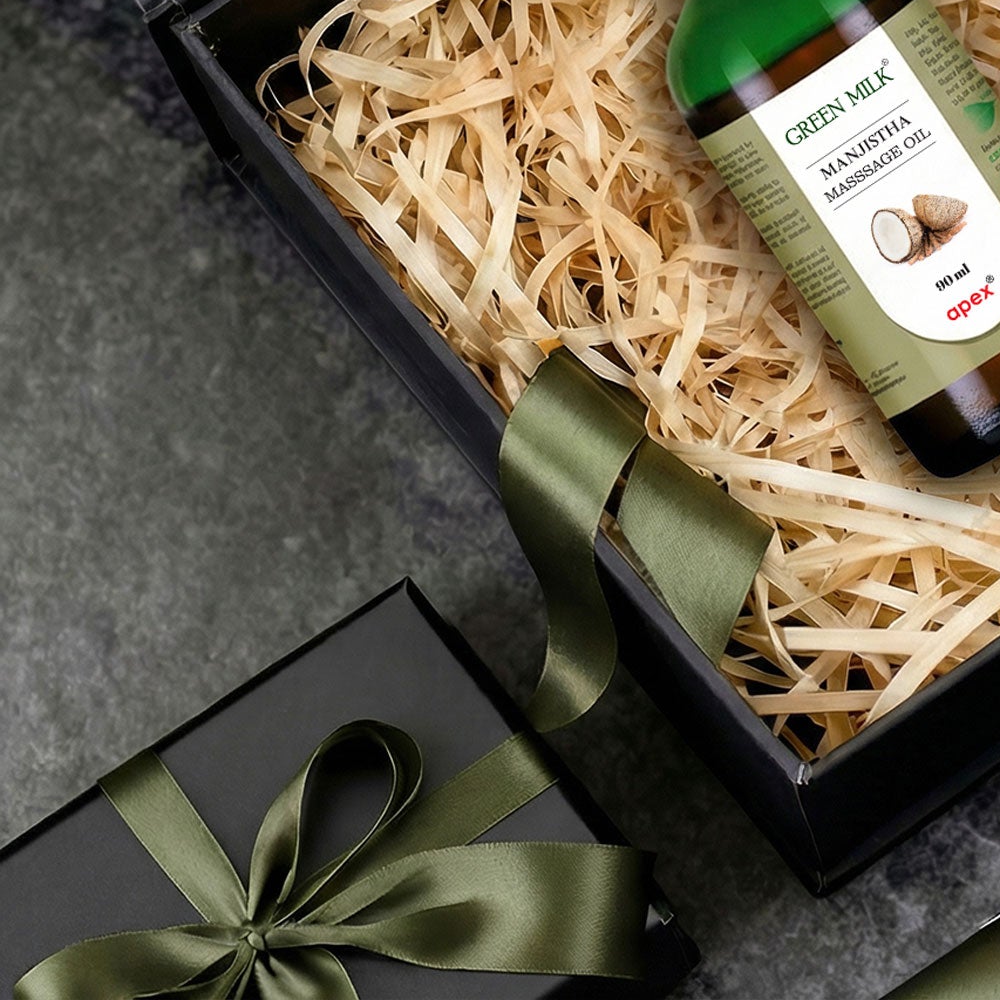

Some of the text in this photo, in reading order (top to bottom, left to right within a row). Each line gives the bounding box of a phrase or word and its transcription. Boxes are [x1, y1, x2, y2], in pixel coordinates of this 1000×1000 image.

[785, 97, 846, 145] GREEN
[819, 115, 912, 181] MANJISTHA
[824, 145, 903, 203] MASSSAGE
[903, 128, 932, 149] OIL
[935, 263, 971, 291] 90 ml
